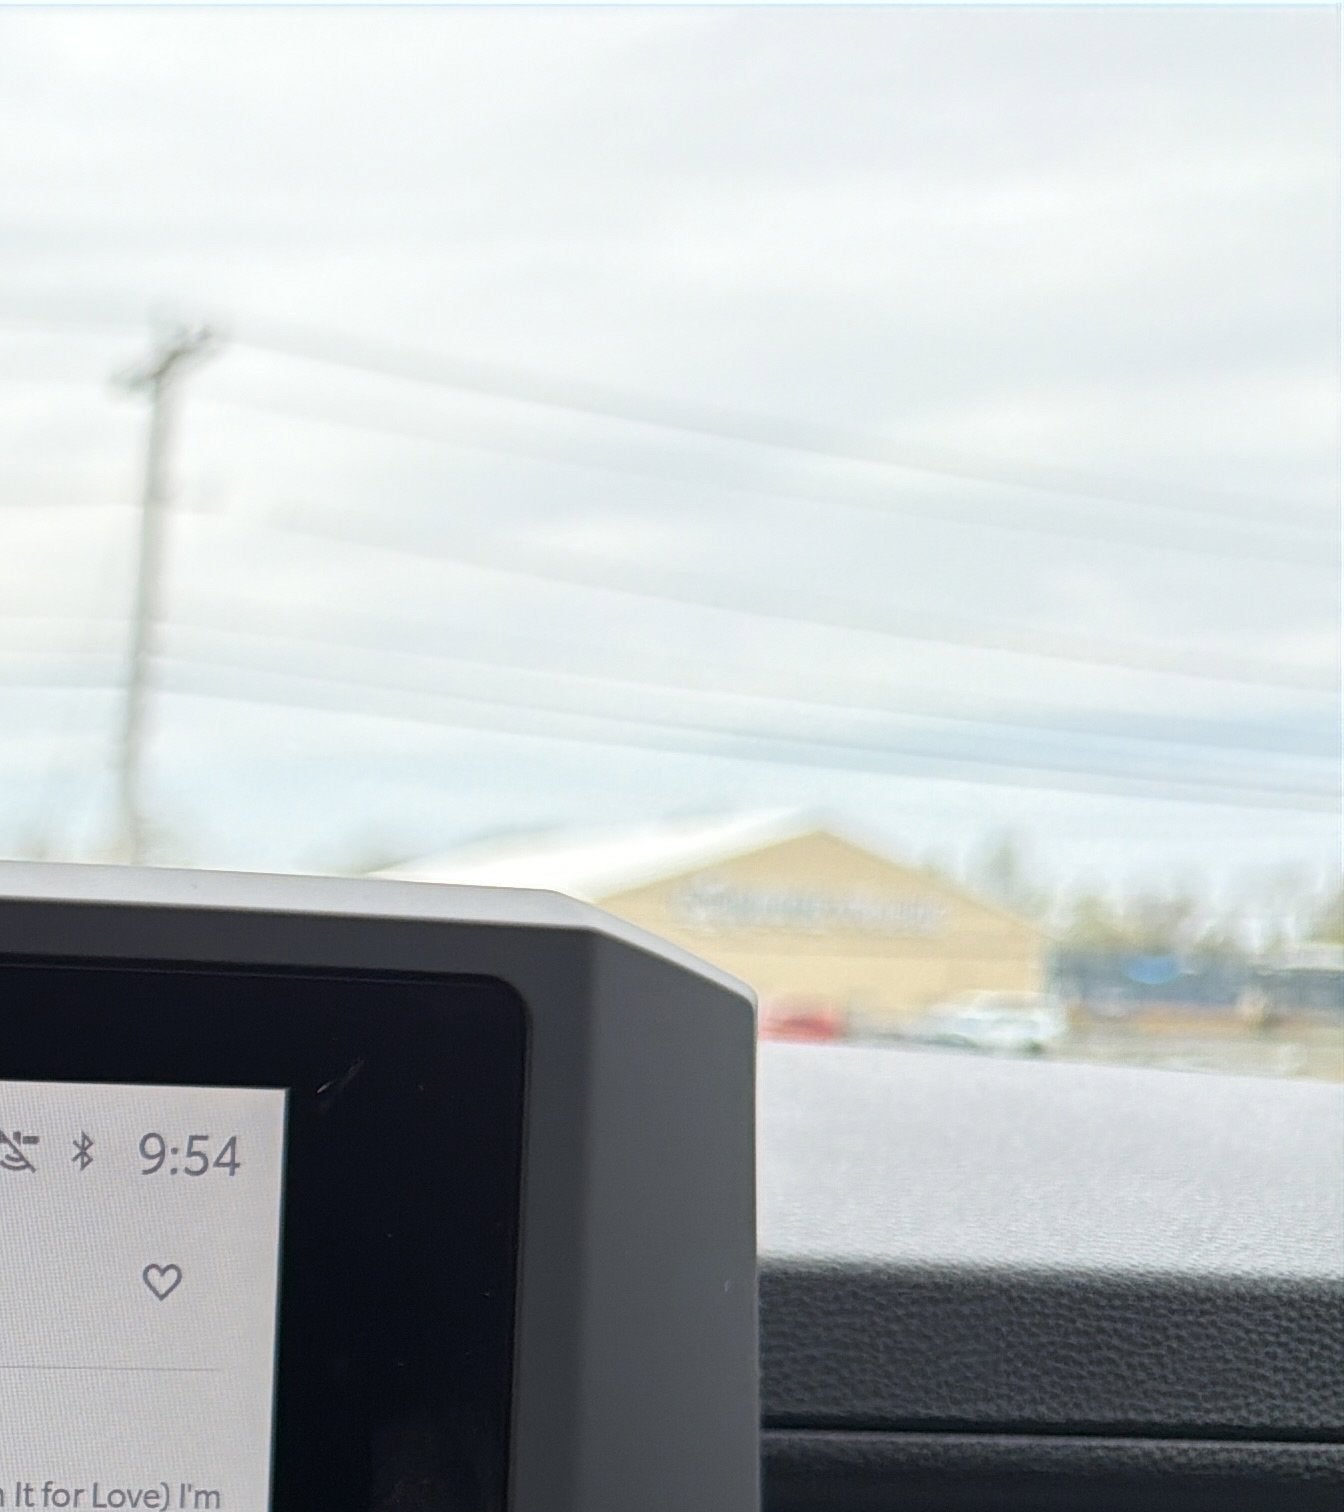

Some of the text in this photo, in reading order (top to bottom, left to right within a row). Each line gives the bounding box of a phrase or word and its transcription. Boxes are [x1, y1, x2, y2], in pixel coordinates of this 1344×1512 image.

[138, 1132, 242, 1177] 9:54
[15, 1482, 35, 1507] It
[43, 1481, 84, 1508] for
[92, 1482, 170, 1512] Love)
[179, 1483, 220, 1509] I'm
